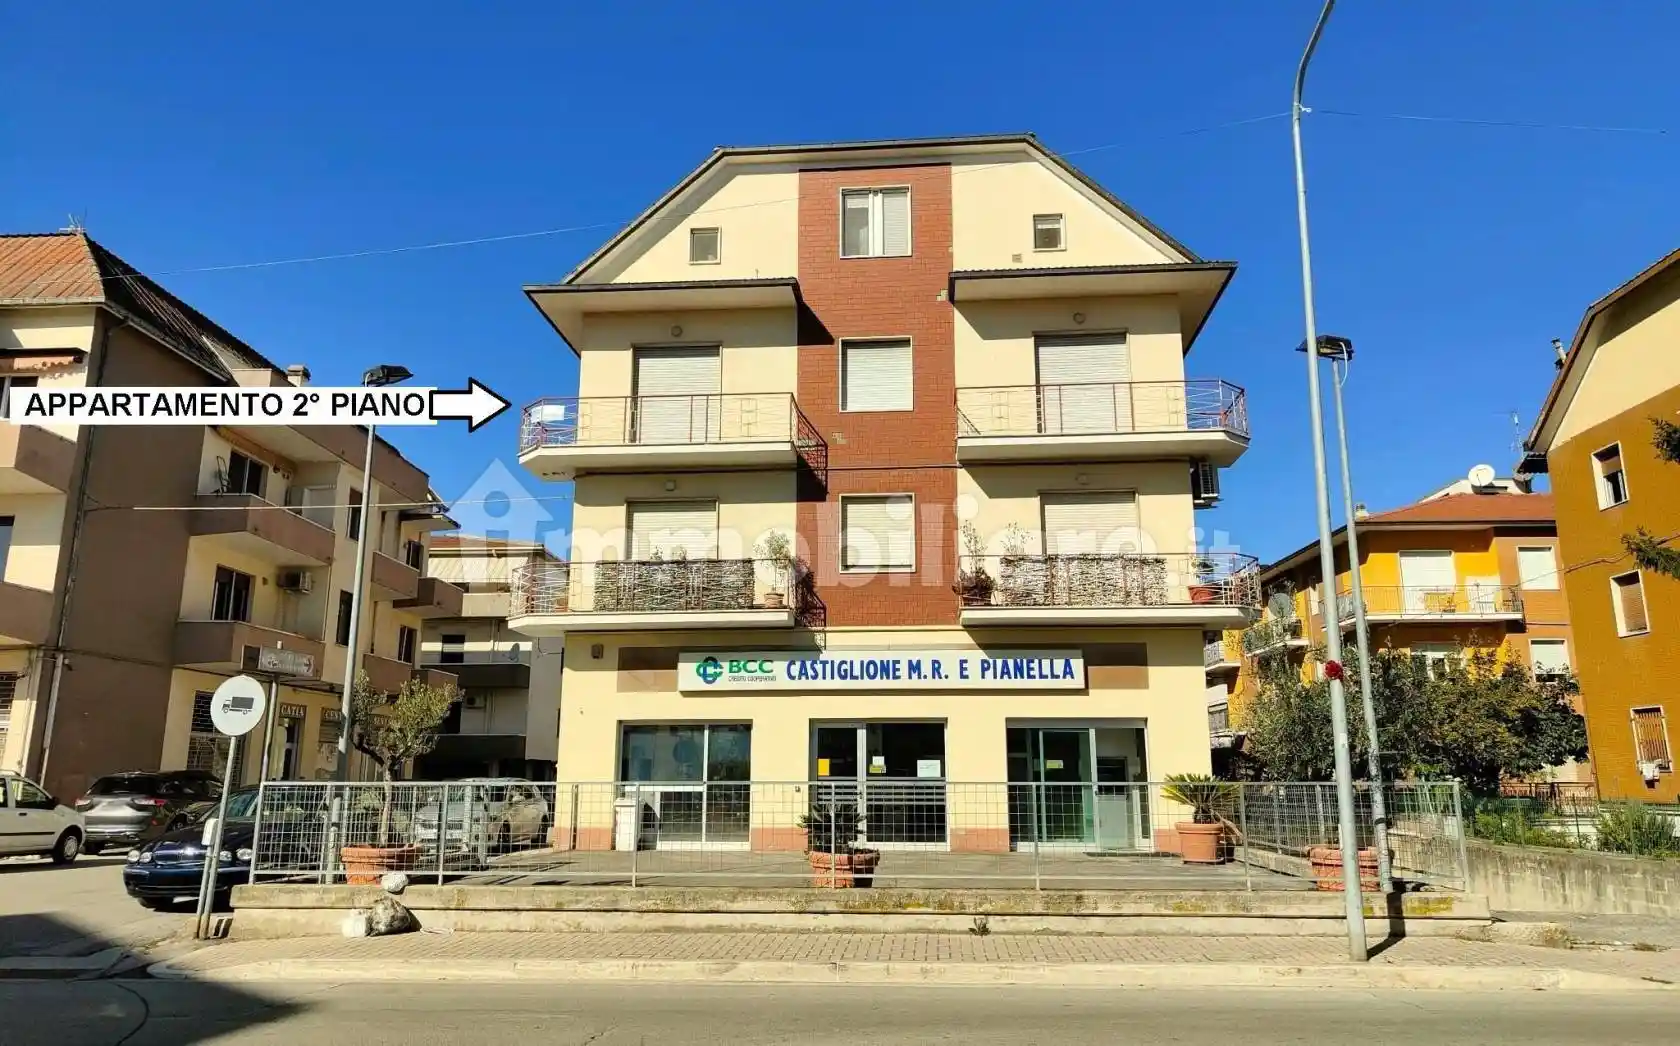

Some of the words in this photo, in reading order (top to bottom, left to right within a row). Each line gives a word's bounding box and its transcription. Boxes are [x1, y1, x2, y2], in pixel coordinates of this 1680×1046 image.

[728, 659, 774, 674] BCC
[786, 659, 902, 681] CASTIGLIONE
[959, 659, 970, 680] E
[980, 658, 1076, 680] PIANELLA
